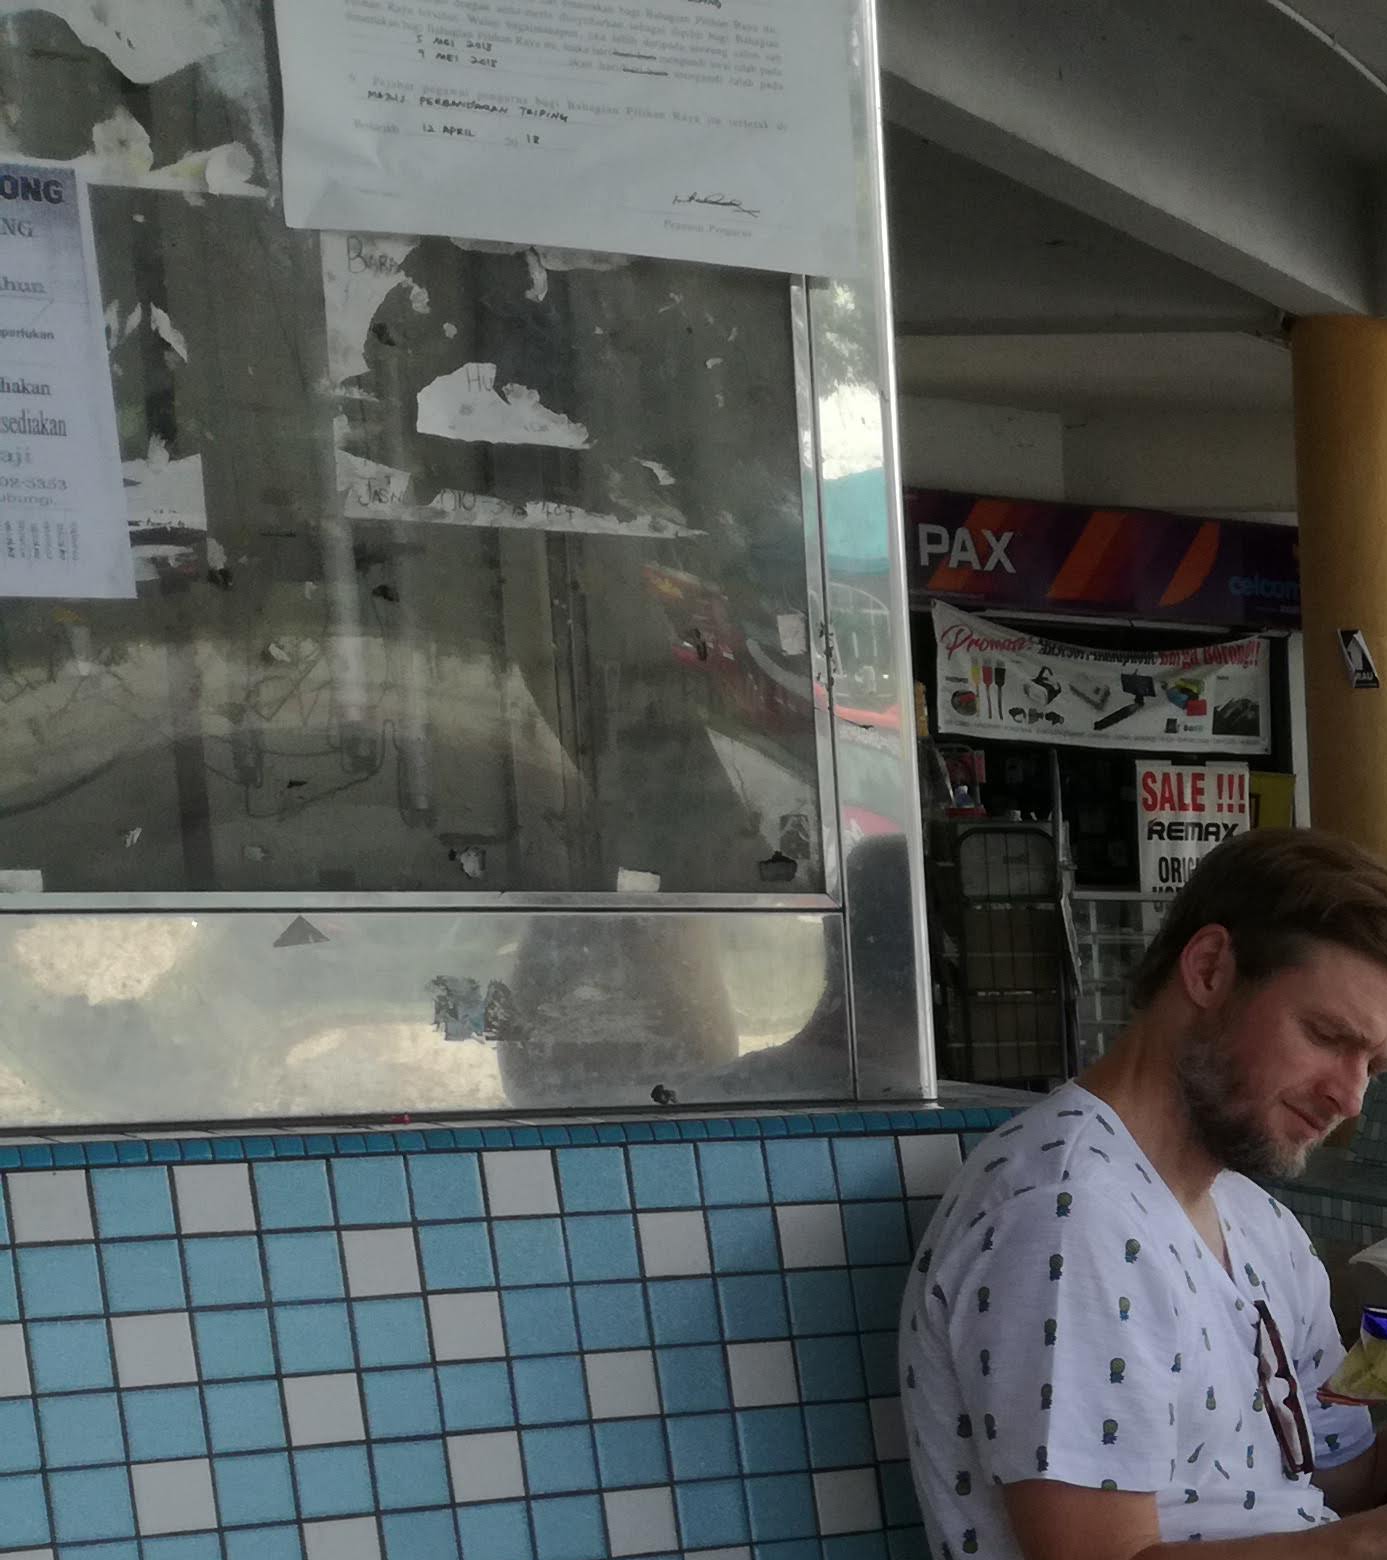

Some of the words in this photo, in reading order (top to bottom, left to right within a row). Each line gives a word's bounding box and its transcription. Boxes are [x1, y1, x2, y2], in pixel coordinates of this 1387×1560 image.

[443, 126, 476, 137] APRIL
[0, 175, 63, 204] ONG
[0, 219, 33, 238] NG
[0, 275, 47, 293] hun
[0, 375, 51, 397] hakan
[0, 407, 67, 437] sediakan
[917, 523, 1017, 573] PAX
[1141, 771, 1206, 813] SALE
[1147, 818, 1239, 842] REMAX
[1159, 856, 1201, 884] ORIG
